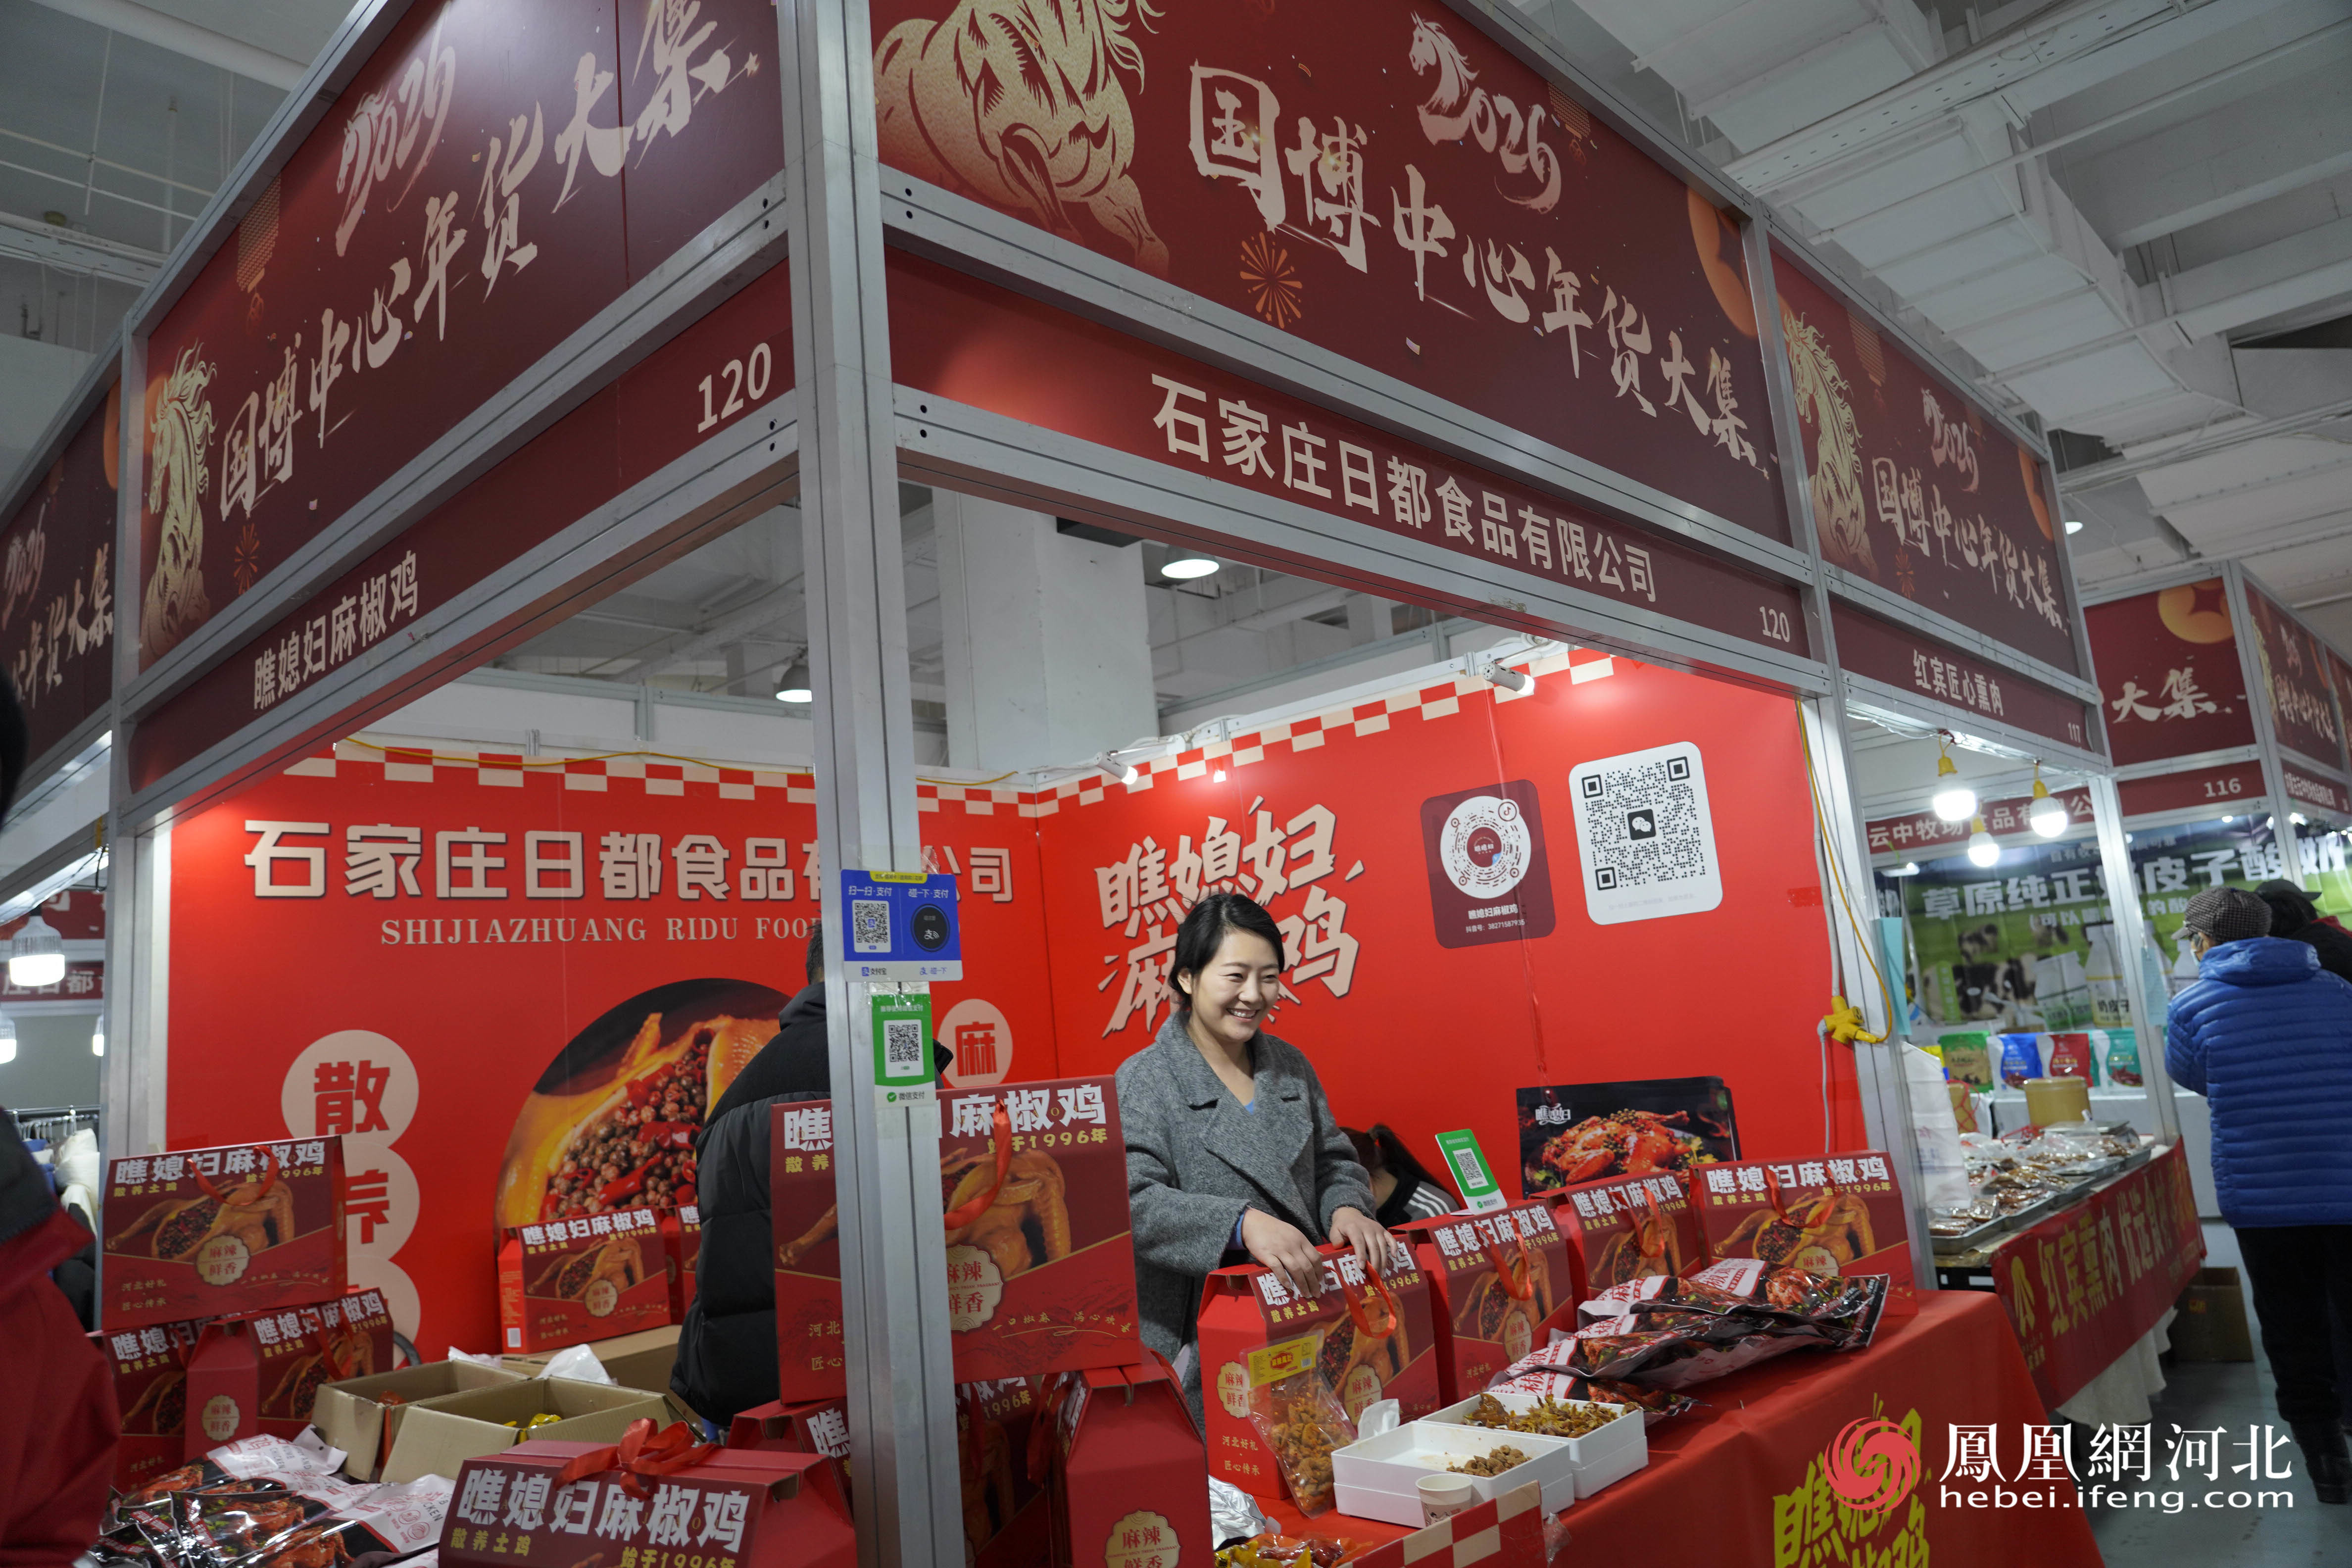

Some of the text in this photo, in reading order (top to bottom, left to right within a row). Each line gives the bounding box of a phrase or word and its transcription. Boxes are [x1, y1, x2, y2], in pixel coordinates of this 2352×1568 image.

[1188, 58, 1758, 468] 国博中心年货大集
[697, 343, 772, 434] 120
[1151, 372, 1657, 602] 石家庄日都食品有限公司
[1872, 456, 2063, 631] 国博中心年货大集
[254, 550, 418, 709] 瞧媳妇麻椒鸡
[1759, 606, 1790, 642] 120
[1913, 649, 2004, 716] 红宾匠心熏肉
[2112, 667, 2217, 724] 大集
[2068, 722, 2081, 742] 117
[2204, 778, 2242, 798] 116
[1468, 903, 1518, 920] 瞧媳妇麻椒鸡
[381, 917, 647, 945] SHIJIAZHUANG
[666, 917, 739, 941] RIDU
[955, 1021, 997, 1077] 麻
[898, 1091, 925, 1101] 微信支付
[1713, 1192, 1766, 1206] 散养土鸡
[522, 1209, 656, 1246] 瞧媳妇麻椒鸡
[1270, 1300, 1320, 1323] 散养土鸡
[456, 1467, 750, 1553] 瞧媳妇麻椒鸡
[450, 1527, 532, 1557] 散养土鸡
[1122, 1525, 1162, 1549] 麻辣
